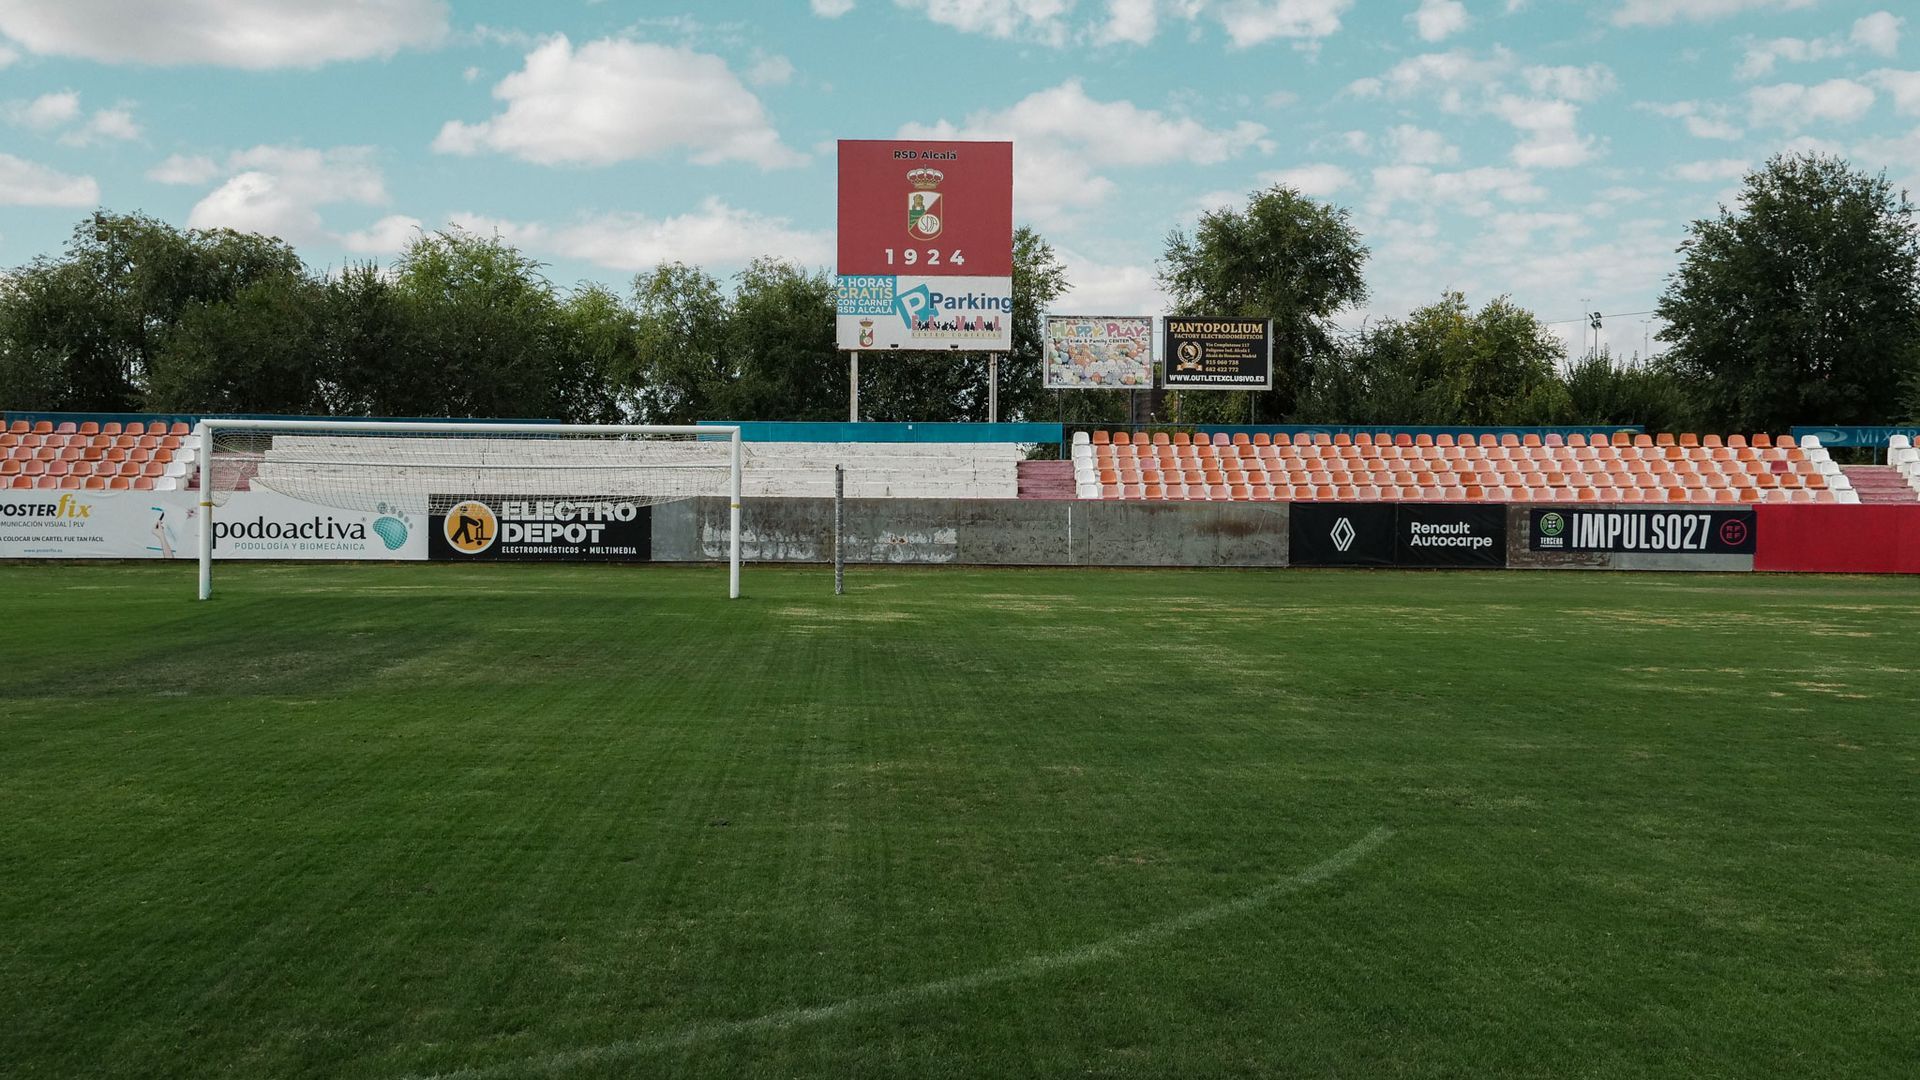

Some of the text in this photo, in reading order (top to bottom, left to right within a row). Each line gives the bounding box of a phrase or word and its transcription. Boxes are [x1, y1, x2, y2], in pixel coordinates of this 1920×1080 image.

[893, 150, 918, 159] RSD
[885, 248, 965, 265] 1924
[837, 277, 893, 288] 2 HORAS
[837, 287, 893, 299] GRATIS
[858, 299, 894, 307] CARNET
[929, 292, 1013, 314] Parking
[1050, 322, 1146, 338] HAPPY PLAY
[1169, 322, 1263, 334] PANTOPOLIUM
[1169, 374, 1265, 382] WWW.OUTLETEXCLUSIVO.ES
[501, 501, 637, 522] ELECTRO
[0, 520, 43, 528] MUNICACIÓN
[1410, 521, 1471, 535] Renault
[212, 515, 367, 549] podoactiva
[501, 523, 606, 543] DEPOT
[1572, 513, 1712, 550] IMPULSO27
[234, 541, 365, 550] PODOLOGÍA Y BIOMECÁNICA
[1410, 534, 1493, 549] Autocarpe
[501, 545, 637, 554] ELECTRODOMÉSTICOS MULTIMEDIA
